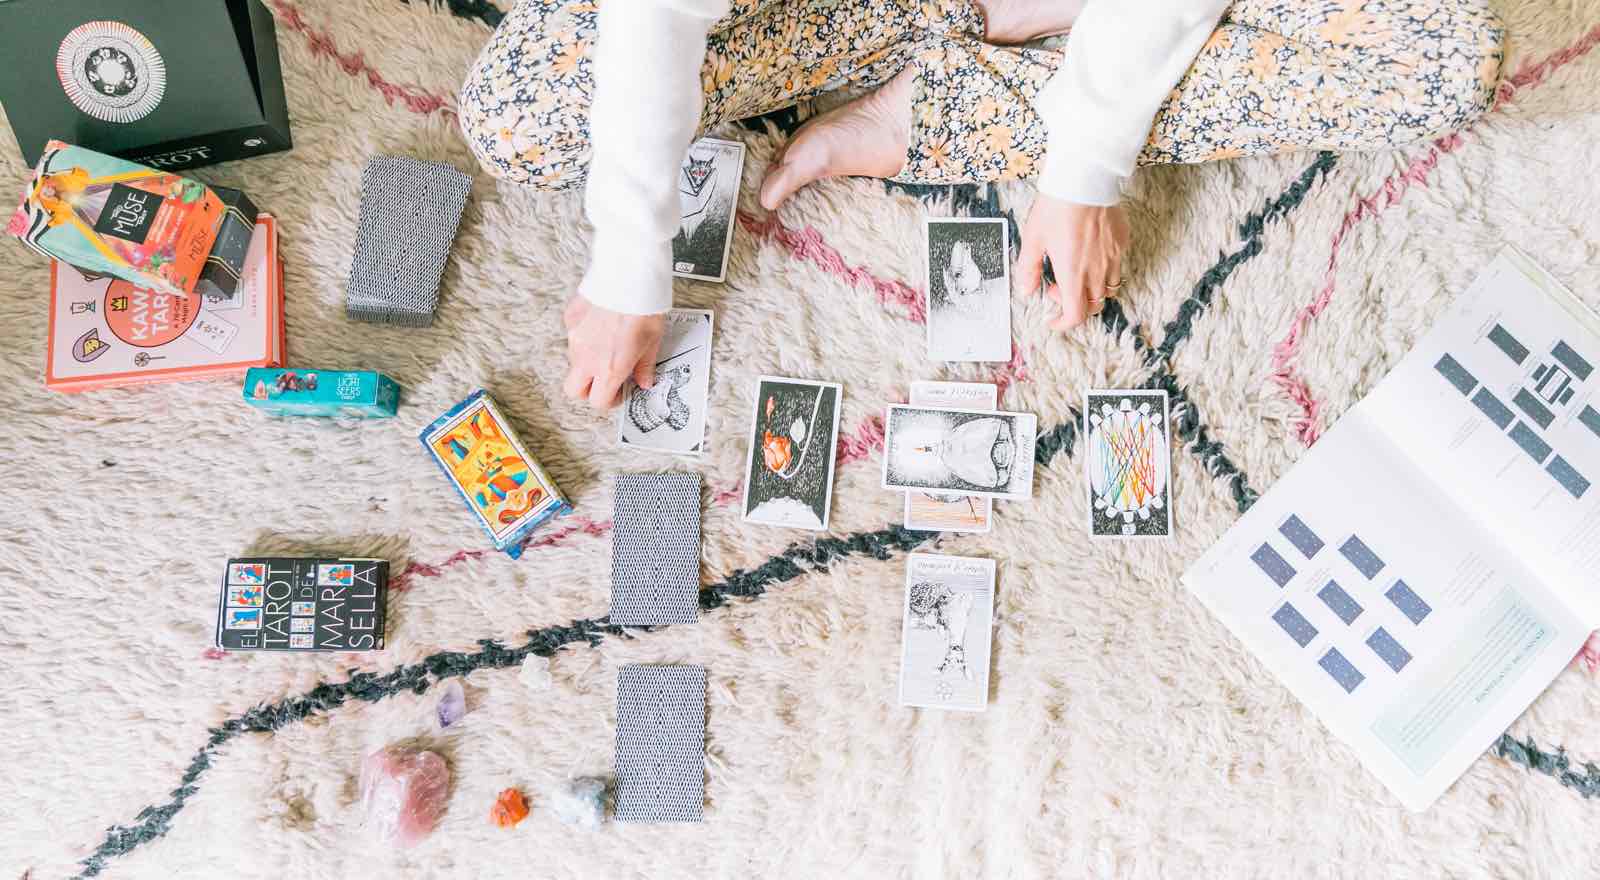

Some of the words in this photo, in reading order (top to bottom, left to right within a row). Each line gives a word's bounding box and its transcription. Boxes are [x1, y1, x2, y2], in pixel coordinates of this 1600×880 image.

[112, 192, 148, 235] MUSE
[264, 564, 293, 648] TAROT
[301, 579, 315, 598] DE
[349, 566, 377, 648] SELLA
[241, 630, 259, 648] EL
[320, 586, 347, 648] MAR
